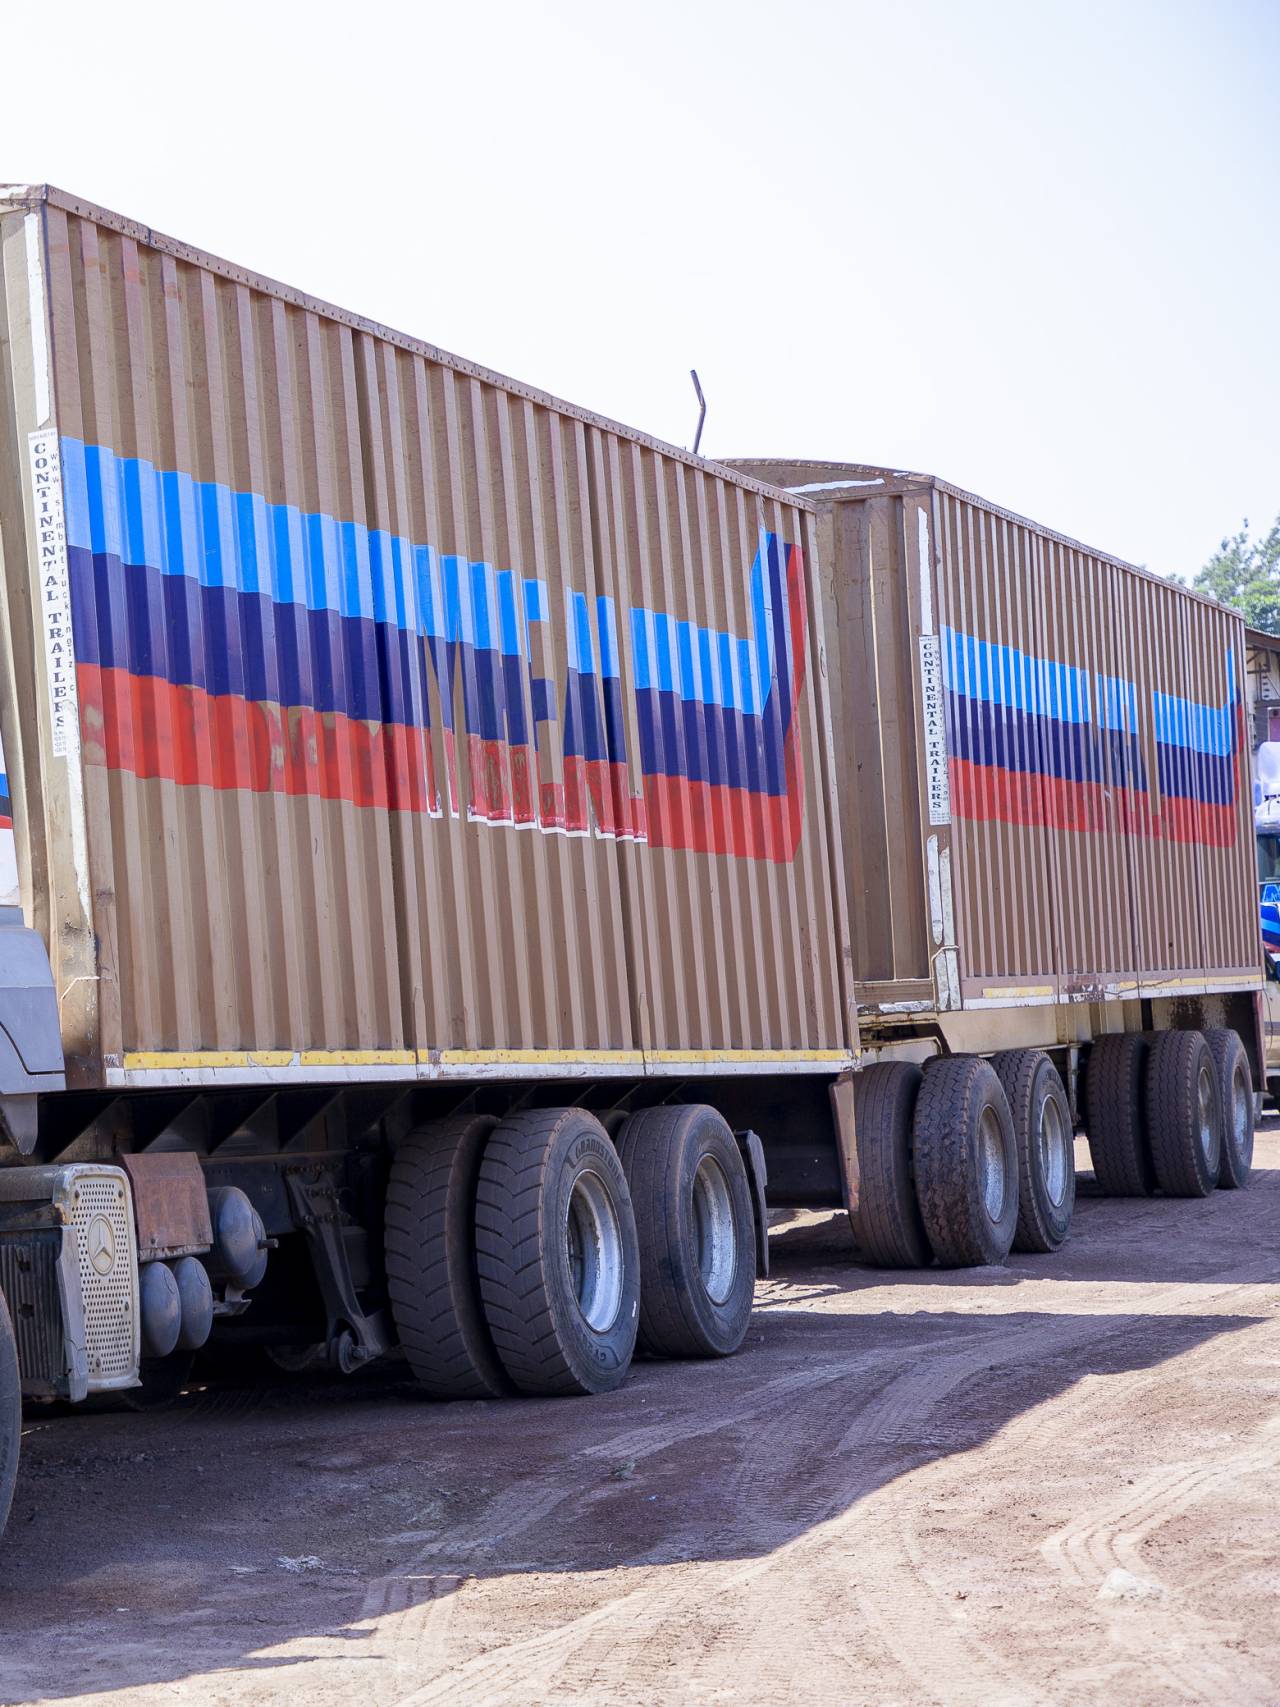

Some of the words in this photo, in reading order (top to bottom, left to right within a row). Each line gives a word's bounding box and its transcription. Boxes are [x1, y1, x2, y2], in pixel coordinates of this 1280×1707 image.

[33, 442, 59, 602] CONTINENTAL
[48, 612, 68, 728] TRAILERS
[923, 643, 938, 736] CONTINENTAL
[929, 741, 942, 809] TRAILERS
